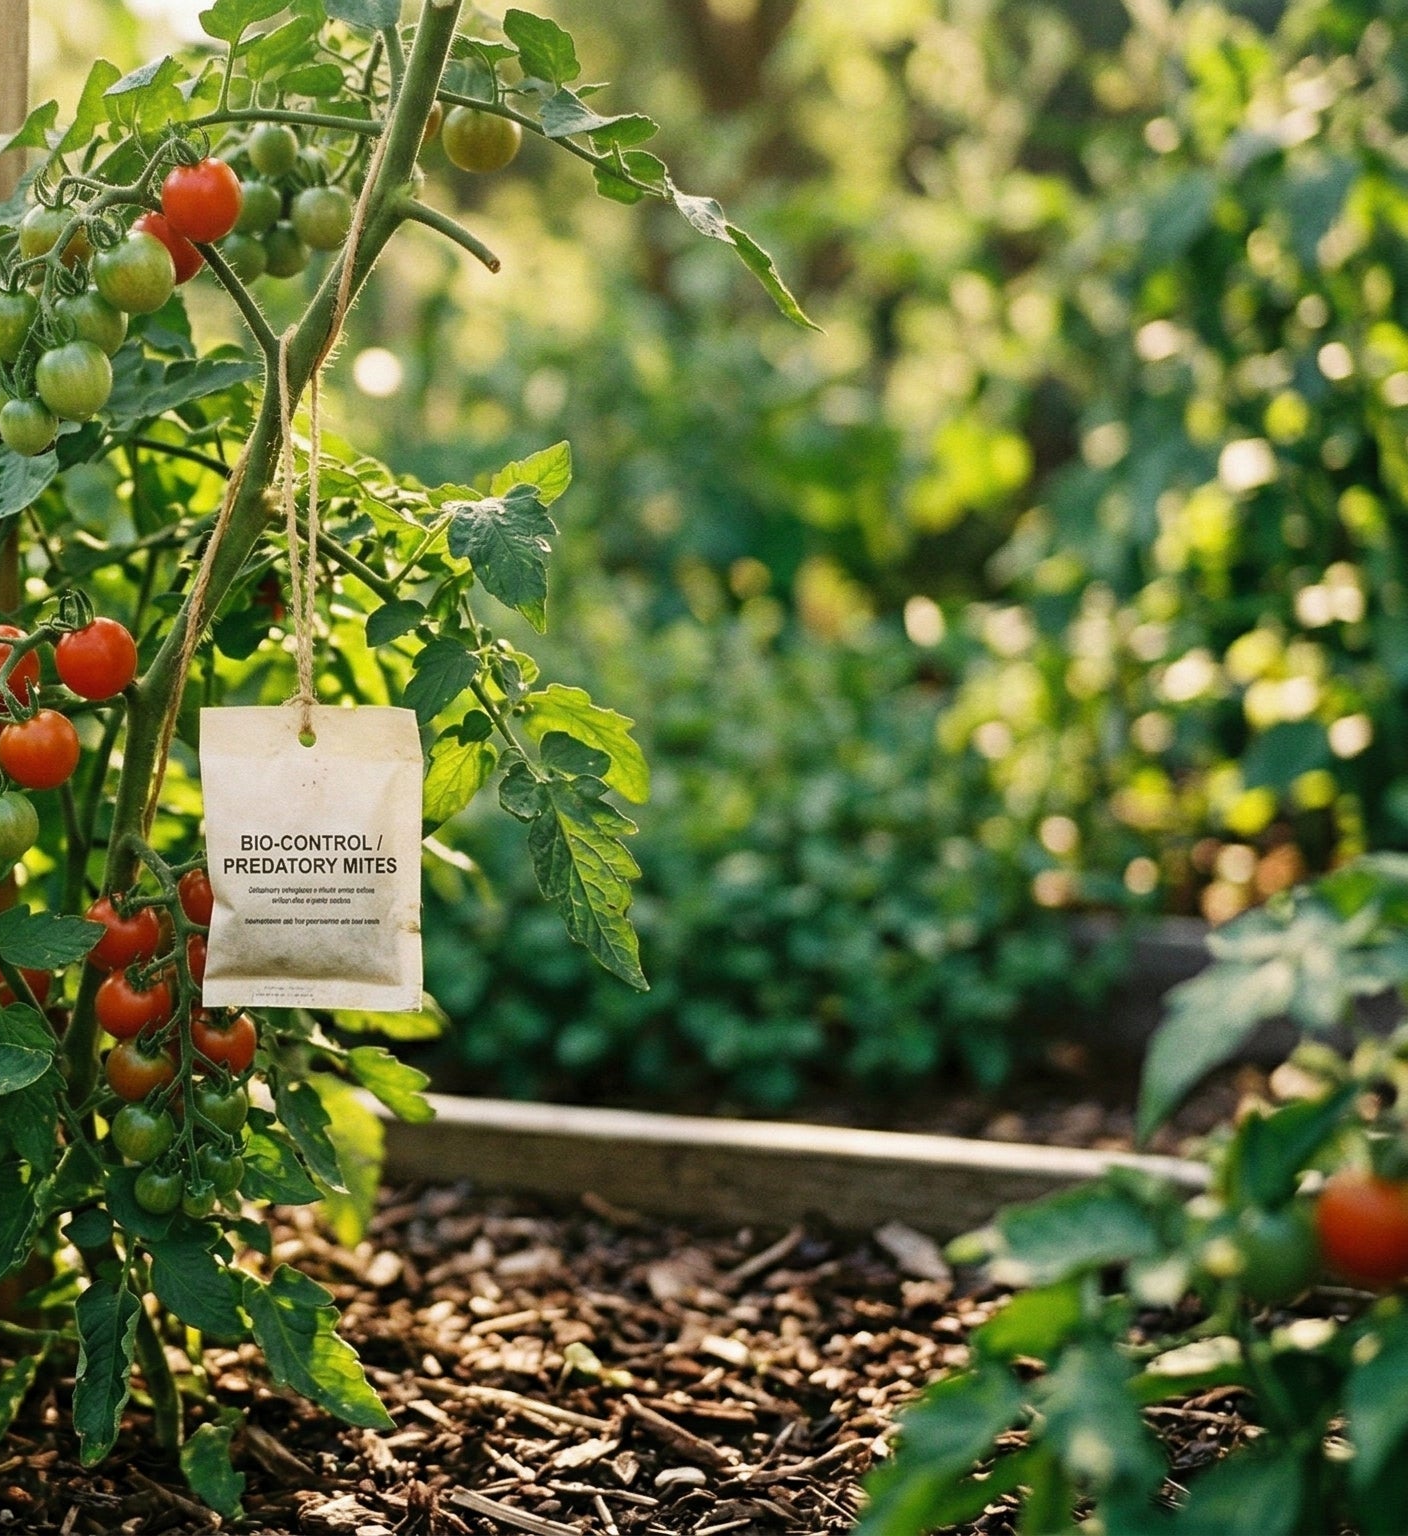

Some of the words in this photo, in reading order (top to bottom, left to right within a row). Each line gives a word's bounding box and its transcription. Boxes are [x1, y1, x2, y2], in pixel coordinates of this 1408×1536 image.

[240, 834, 372, 851] BIO-CONTROL
[376, 834, 383, 852] /
[223, 857, 338, 874] PREDATORY
[343, 857, 397, 874] MITES
